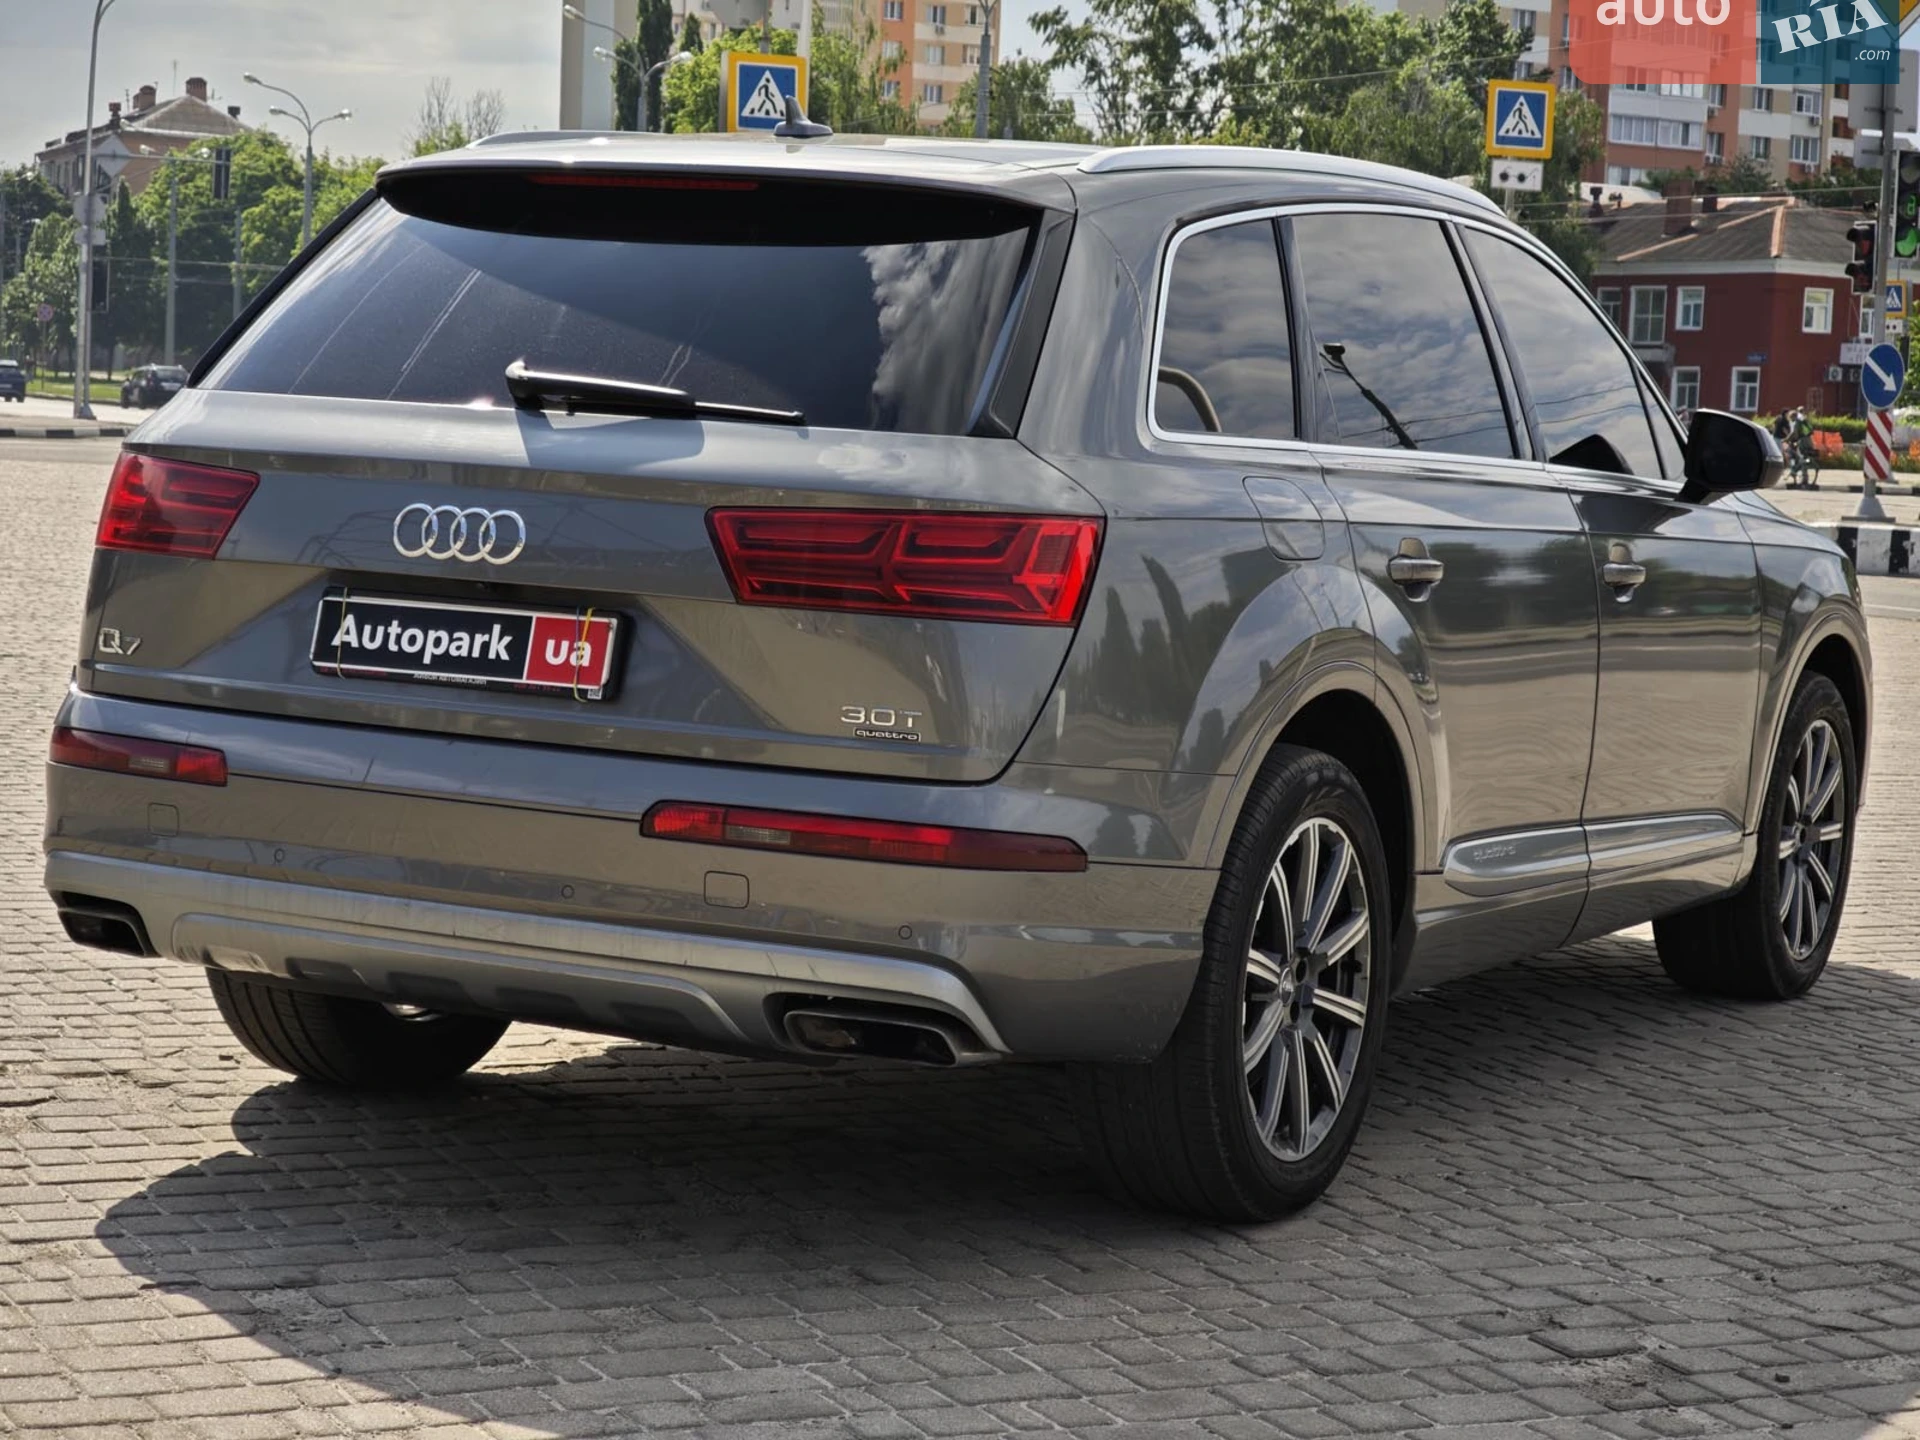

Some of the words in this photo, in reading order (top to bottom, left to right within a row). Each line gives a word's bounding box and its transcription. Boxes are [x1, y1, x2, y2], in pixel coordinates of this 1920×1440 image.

[98, 627, 142, 656] Q7
[331, 613, 513, 665] Autopark
[545, 637, 592, 667] ua
[856, 729, 919, 740] quattro
